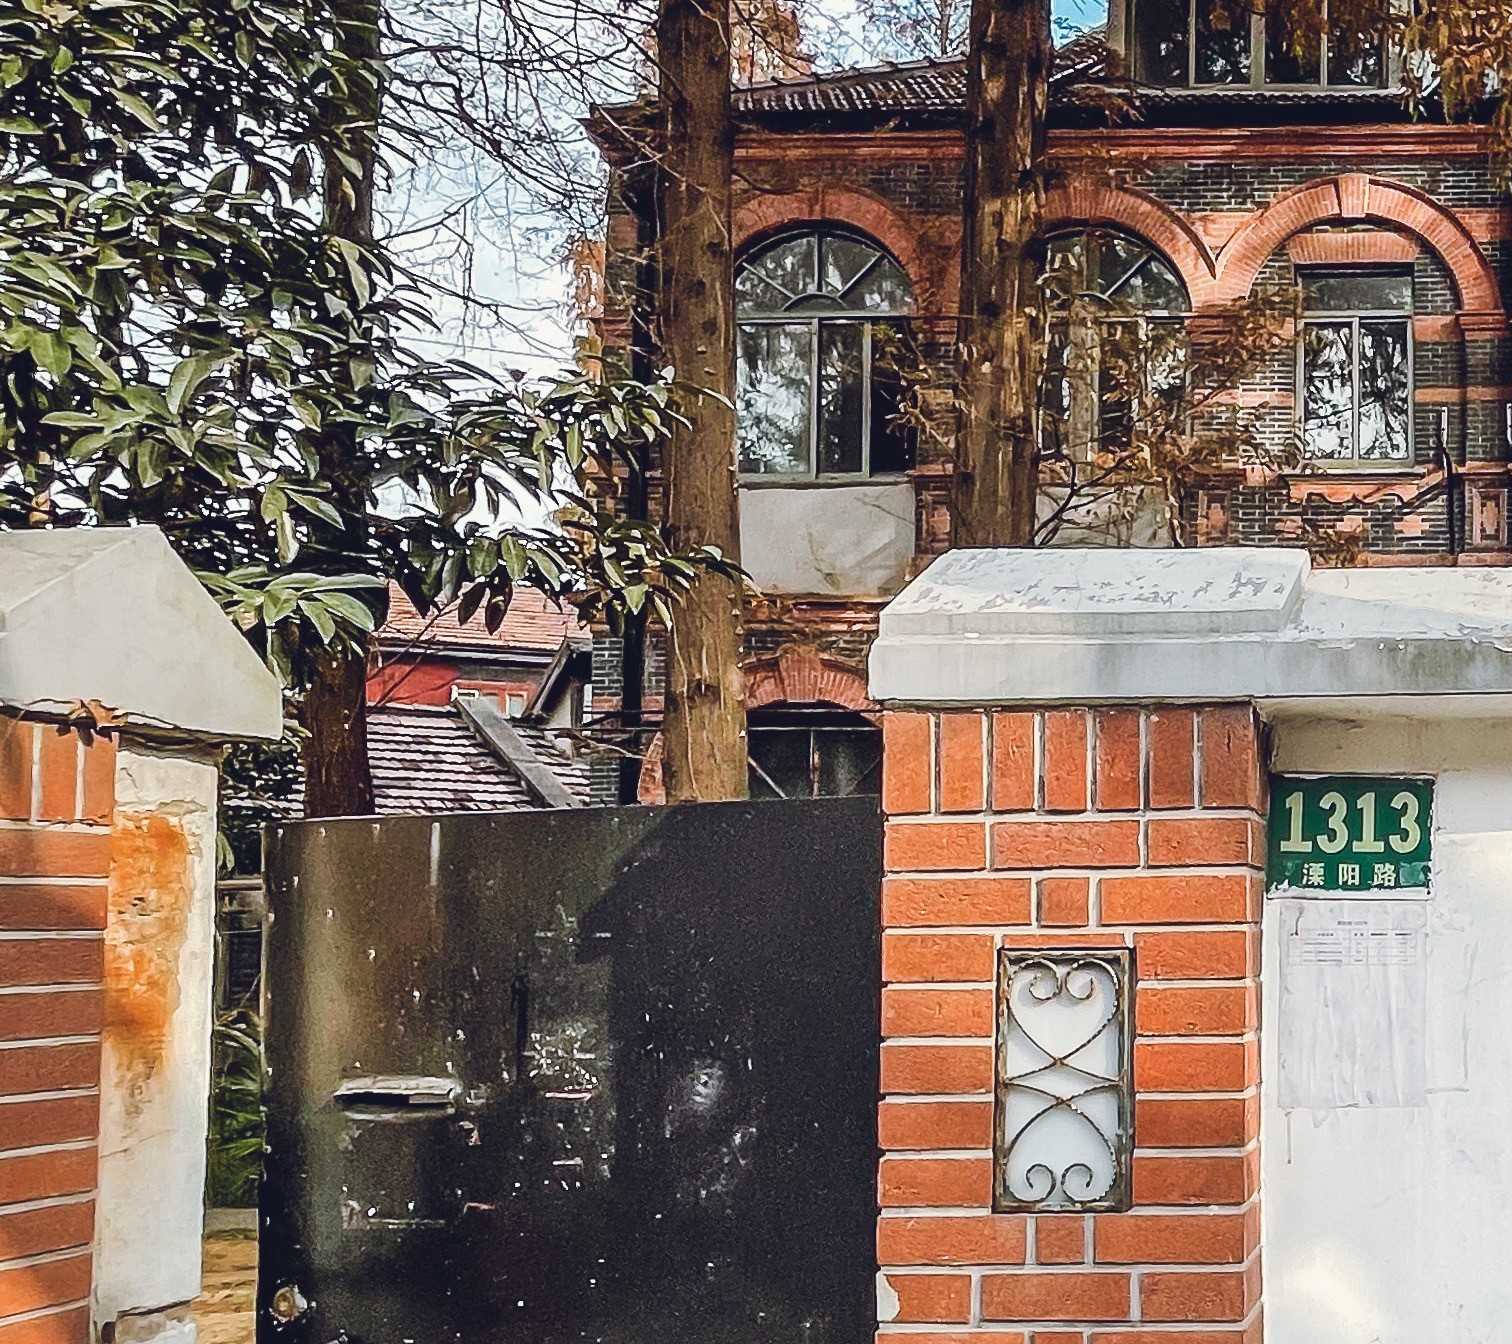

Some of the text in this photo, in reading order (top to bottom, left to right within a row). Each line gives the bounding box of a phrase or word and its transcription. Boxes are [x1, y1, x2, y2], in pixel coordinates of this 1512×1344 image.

[1280, 791, 1421, 854] 1313
[1302, 862, 1397, 887] 溧阳路
